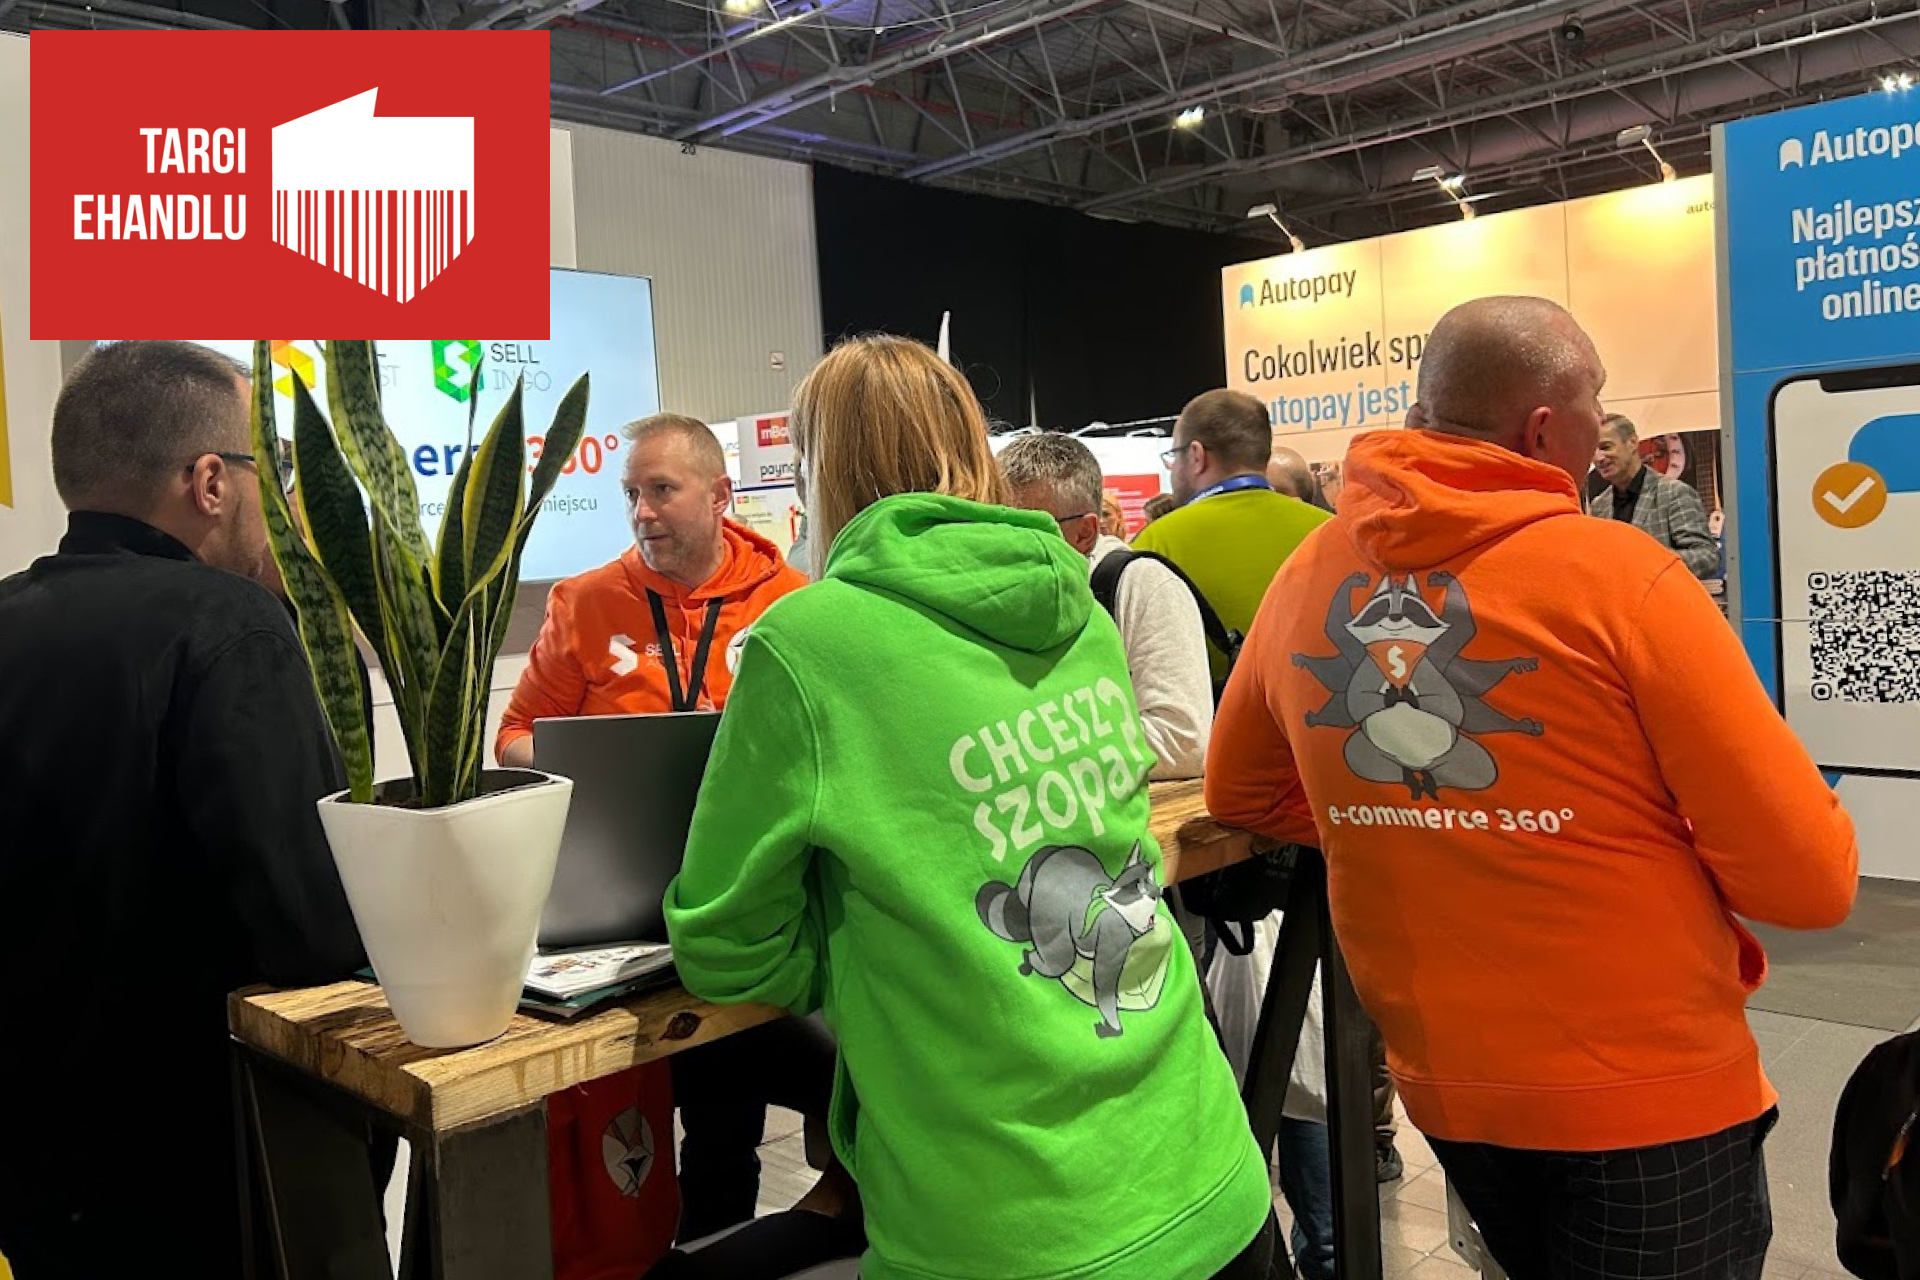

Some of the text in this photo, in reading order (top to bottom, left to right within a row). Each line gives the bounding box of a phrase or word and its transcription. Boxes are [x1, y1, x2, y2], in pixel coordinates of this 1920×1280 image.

[1259, 269, 1357, 307] Autopay
[490, 343, 541, 364] SELL
[1244, 331, 1382, 383] Cokolwiek
[1357, 380, 1410, 424] jest
[949, 686, 1113, 793] CHCESZ
[1329, 804, 1574, 833] e-commerce 360°
